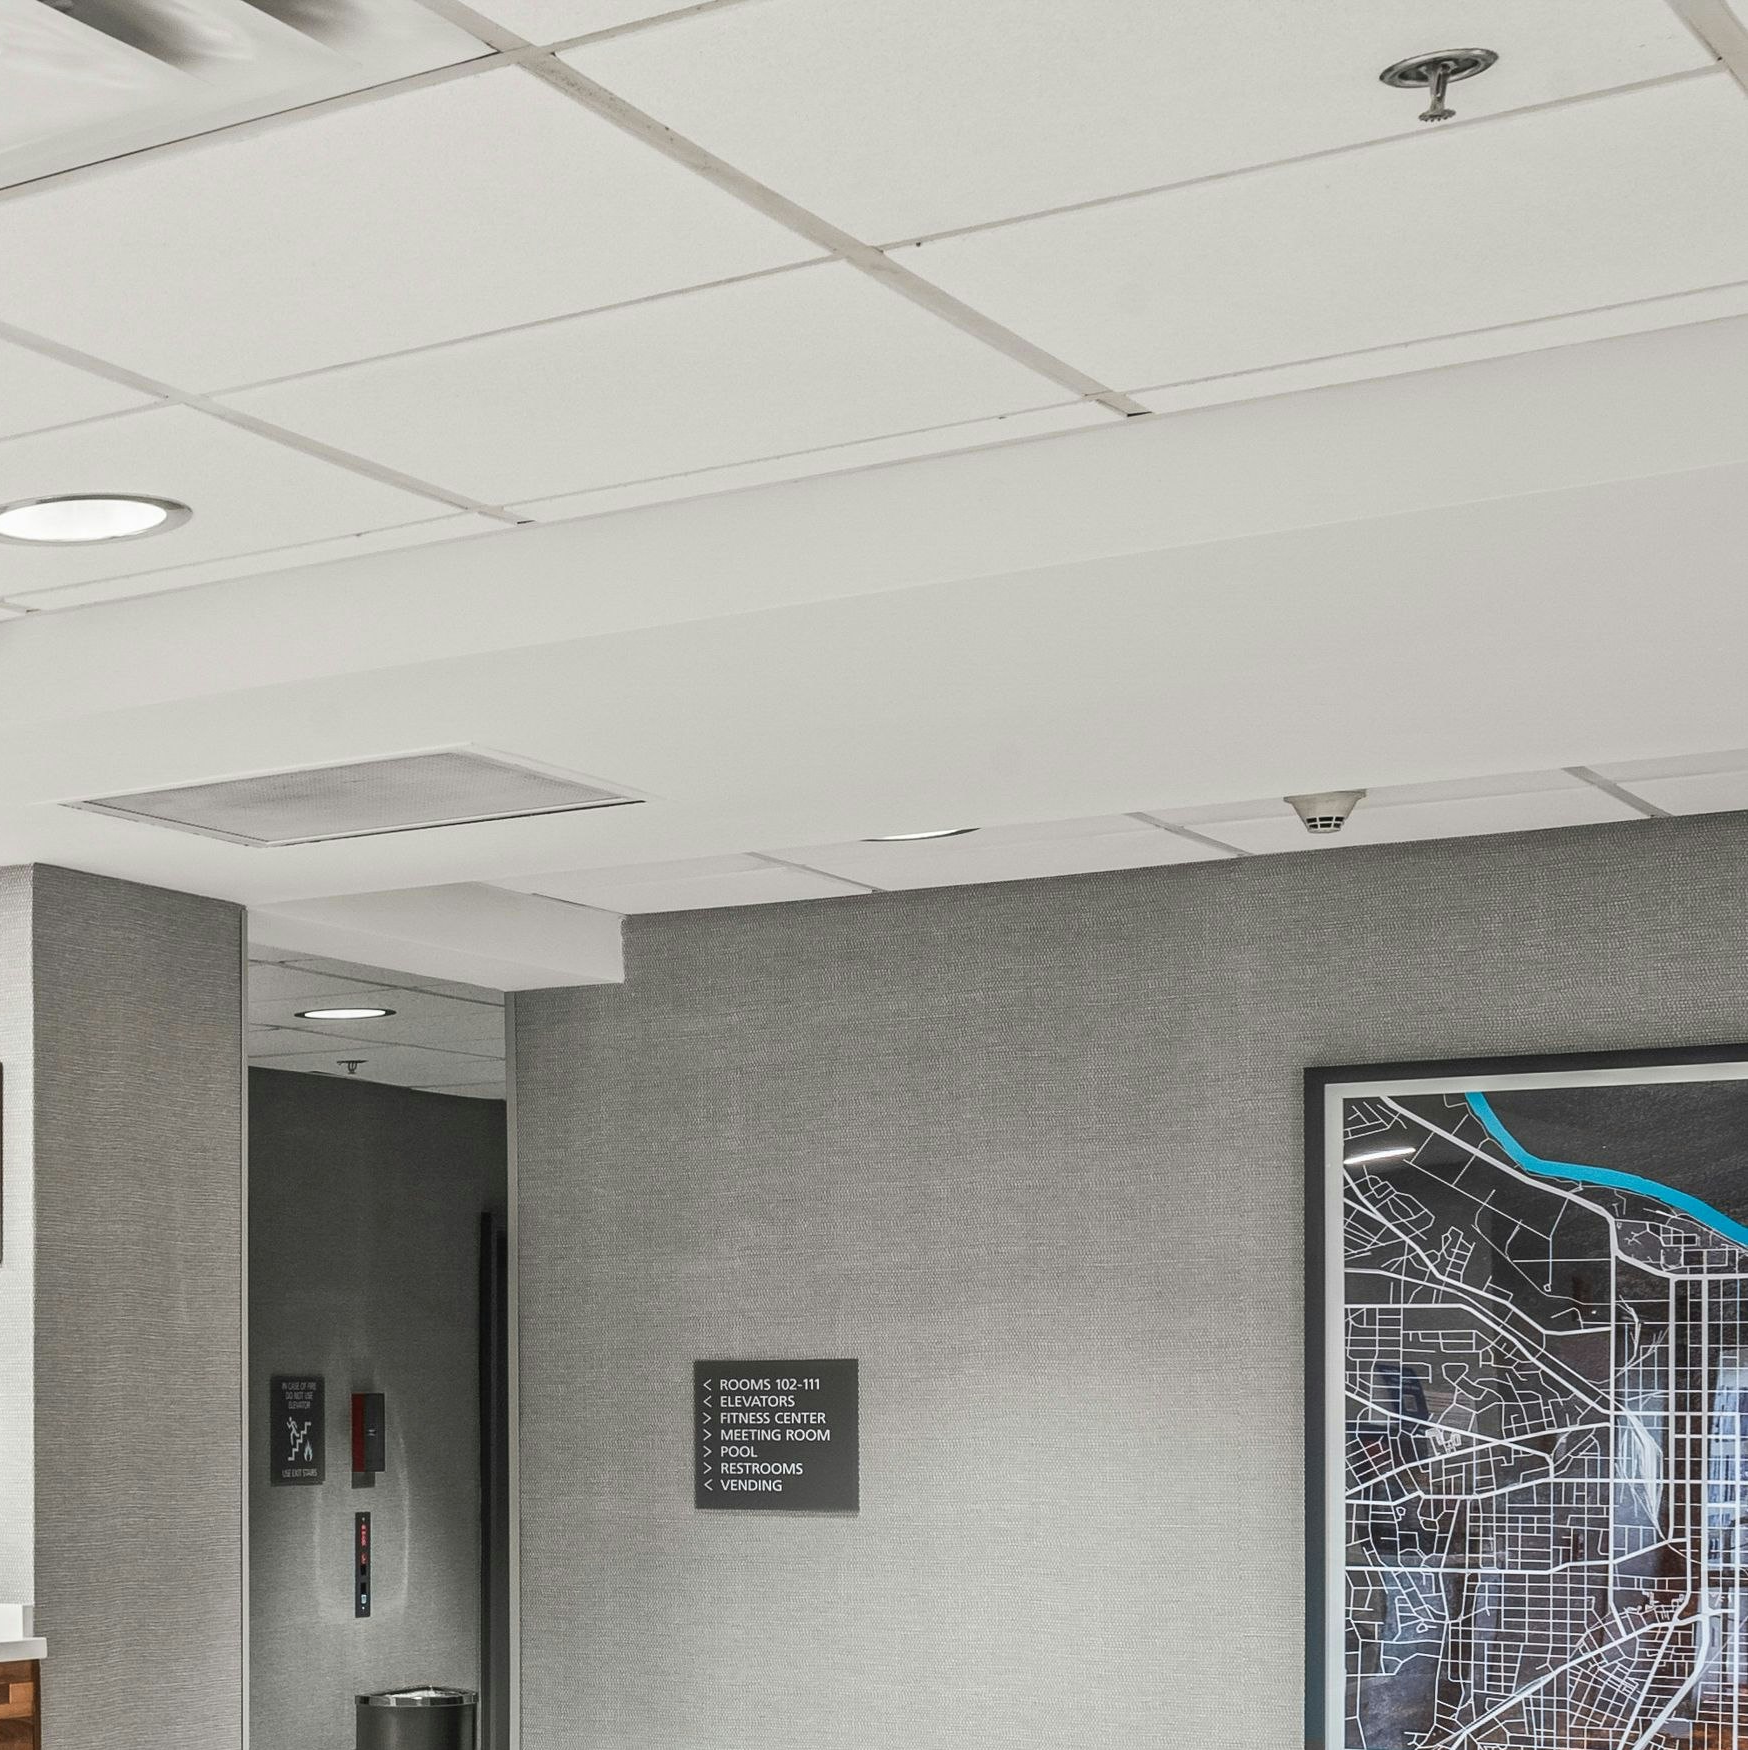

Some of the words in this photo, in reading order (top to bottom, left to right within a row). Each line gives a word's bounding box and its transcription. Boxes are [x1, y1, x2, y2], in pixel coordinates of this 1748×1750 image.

[719, 1378, 771, 1391] ROOMS
[775, 1378, 821, 1391] 102-111
[288, 1401, 311, 1410] ELEVATOR
[720, 1395, 796, 1408] ELEVATORS
[720, 1412, 771, 1424] FITNESS
[774, 1412, 826, 1424] CENTER
[720, 1429, 782, 1441] MEETING
[786, 1429, 831, 1441] ROOM
[720, 1446, 758, 1458] POOL
[720, 1462, 804, 1475] RESTROOMS
[720, 1479, 783, 1492] VENDING
